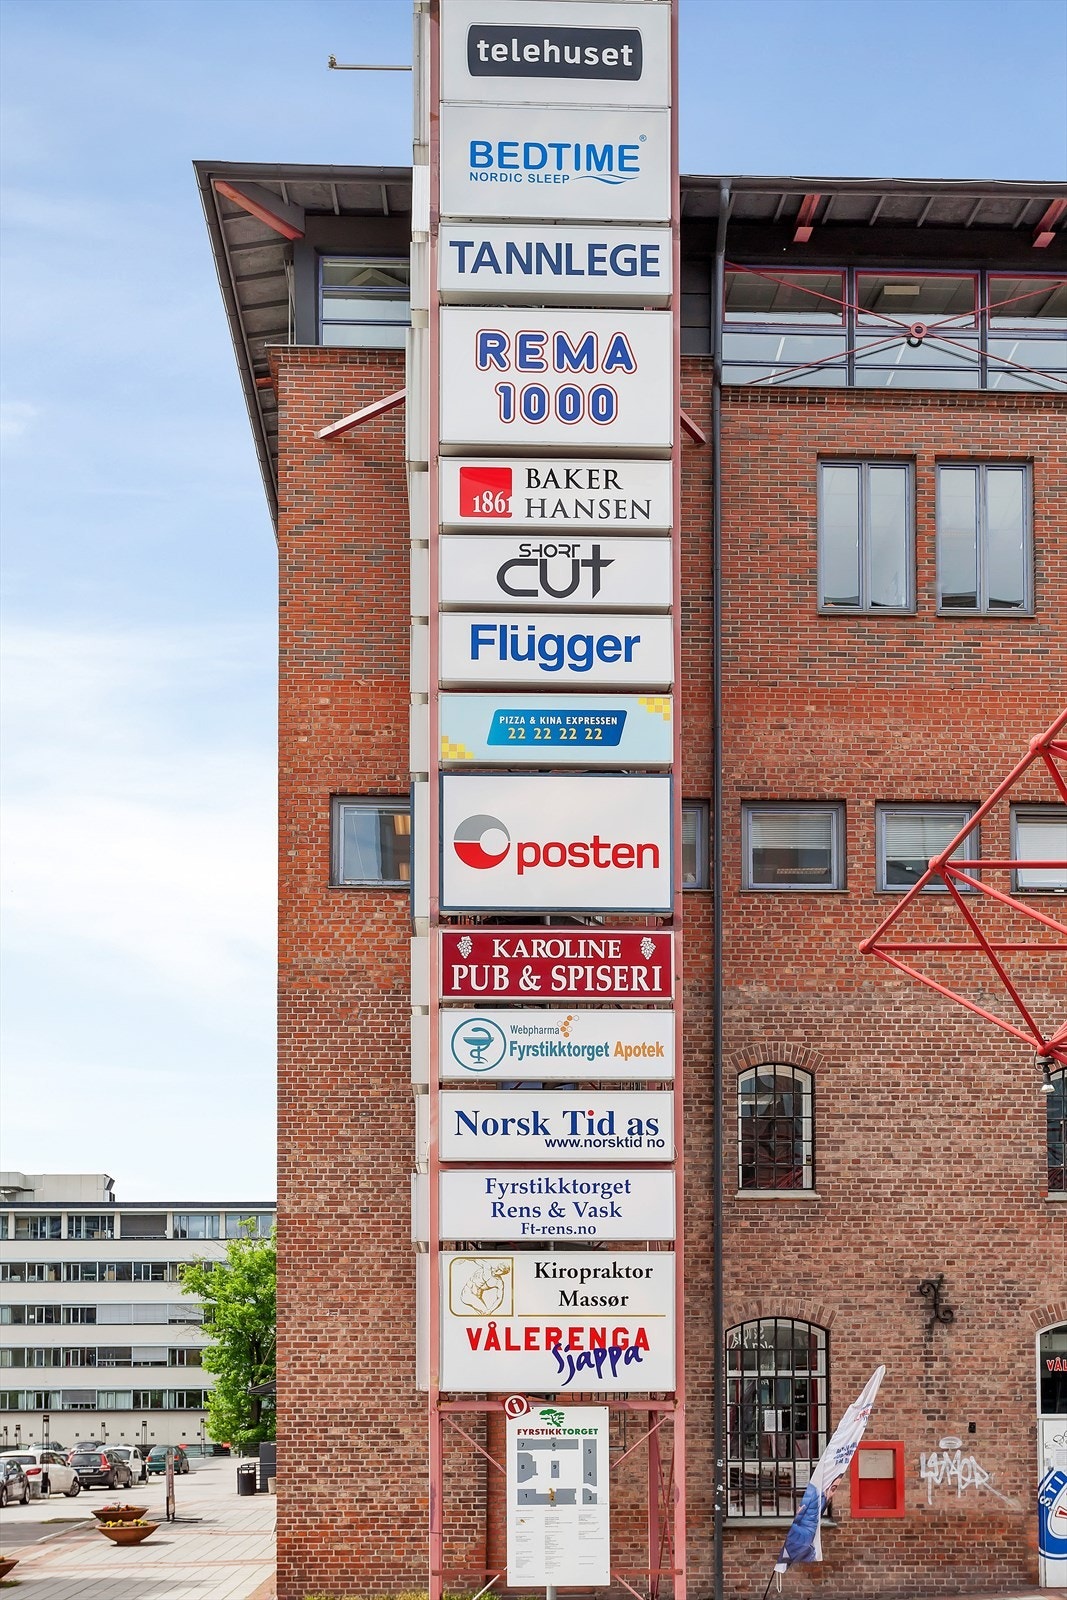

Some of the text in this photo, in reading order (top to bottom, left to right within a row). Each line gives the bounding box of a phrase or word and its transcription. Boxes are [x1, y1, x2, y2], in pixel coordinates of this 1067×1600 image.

[477, 38, 633, 67] telehuset
[469, 140, 640, 172] BEDTIME
[469, 172, 571, 184] NORDIC SLEEP
[449, 240, 660, 277] TANNLEGE
[475, 328, 637, 374] REMA
[494, 381, 618, 425] 1000
[525, 468, 623, 490] BAKER
[524, 498, 652, 520] HANSEN
[518, 543, 581, 559] SHORT
[470, 623, 641, 672] Flügger
[499, 716, 617, 725] PIZZA & KINA EXPRESSEN
[508, 728, 603, 740] 22 22 22 22
[517, 835, 660, 875] posten
[492, 939, 622, 959] KAROLINE
[451, 964, 662, 991] PUB & SPISERI
[510, 1025, 560, 1037] Webpharma
[509, 1041, 665, 1061] Fyrstikktorget Apotek
[454, 1109, 659, 1137] Norsk Tid as
[544, 1136, 665, 1148] www.norsktid no
[485, 1177, 632, 1199] Fyrstikktorget
[491, 1201, 623, 1219] Rens & Vask
[521, 1222, 597, 1236] Ft-rens.no
[534, 1261, 654, 1284] Kiropraktor
[558, 1289, 629, 1308] Massør
[466, 1321, 650, 1351] VÅLERENGA
[517, 1428, 599, 1436] FYRSTIKKTORGET
